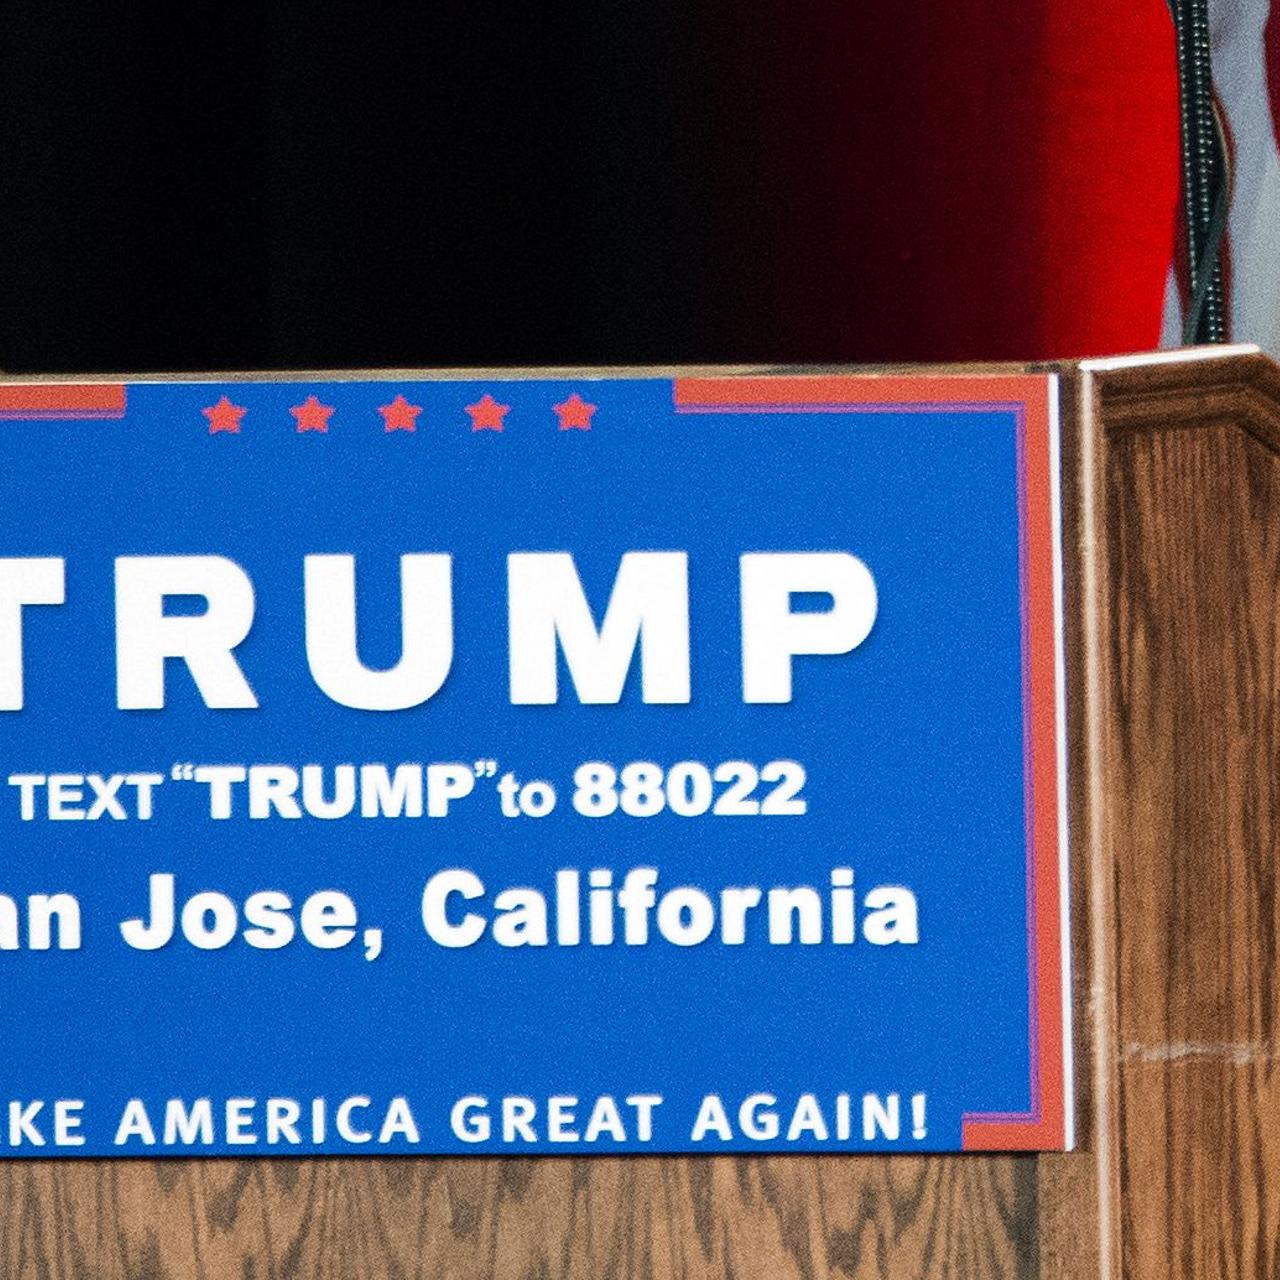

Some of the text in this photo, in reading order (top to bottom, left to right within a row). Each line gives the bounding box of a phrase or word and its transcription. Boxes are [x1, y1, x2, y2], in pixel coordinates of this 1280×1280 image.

[8, 773, 164, 821] TEXT
[572, 760, 808, 818] 88022
[119, 873, 383, 962] Jose,
[421, 867, 920, 948] California
[114, 1096, 421, 1145] AMERICA
[450, 1095, 663, 1143] GREAT
[691, 1092, 928, 1141] AGAIN!
